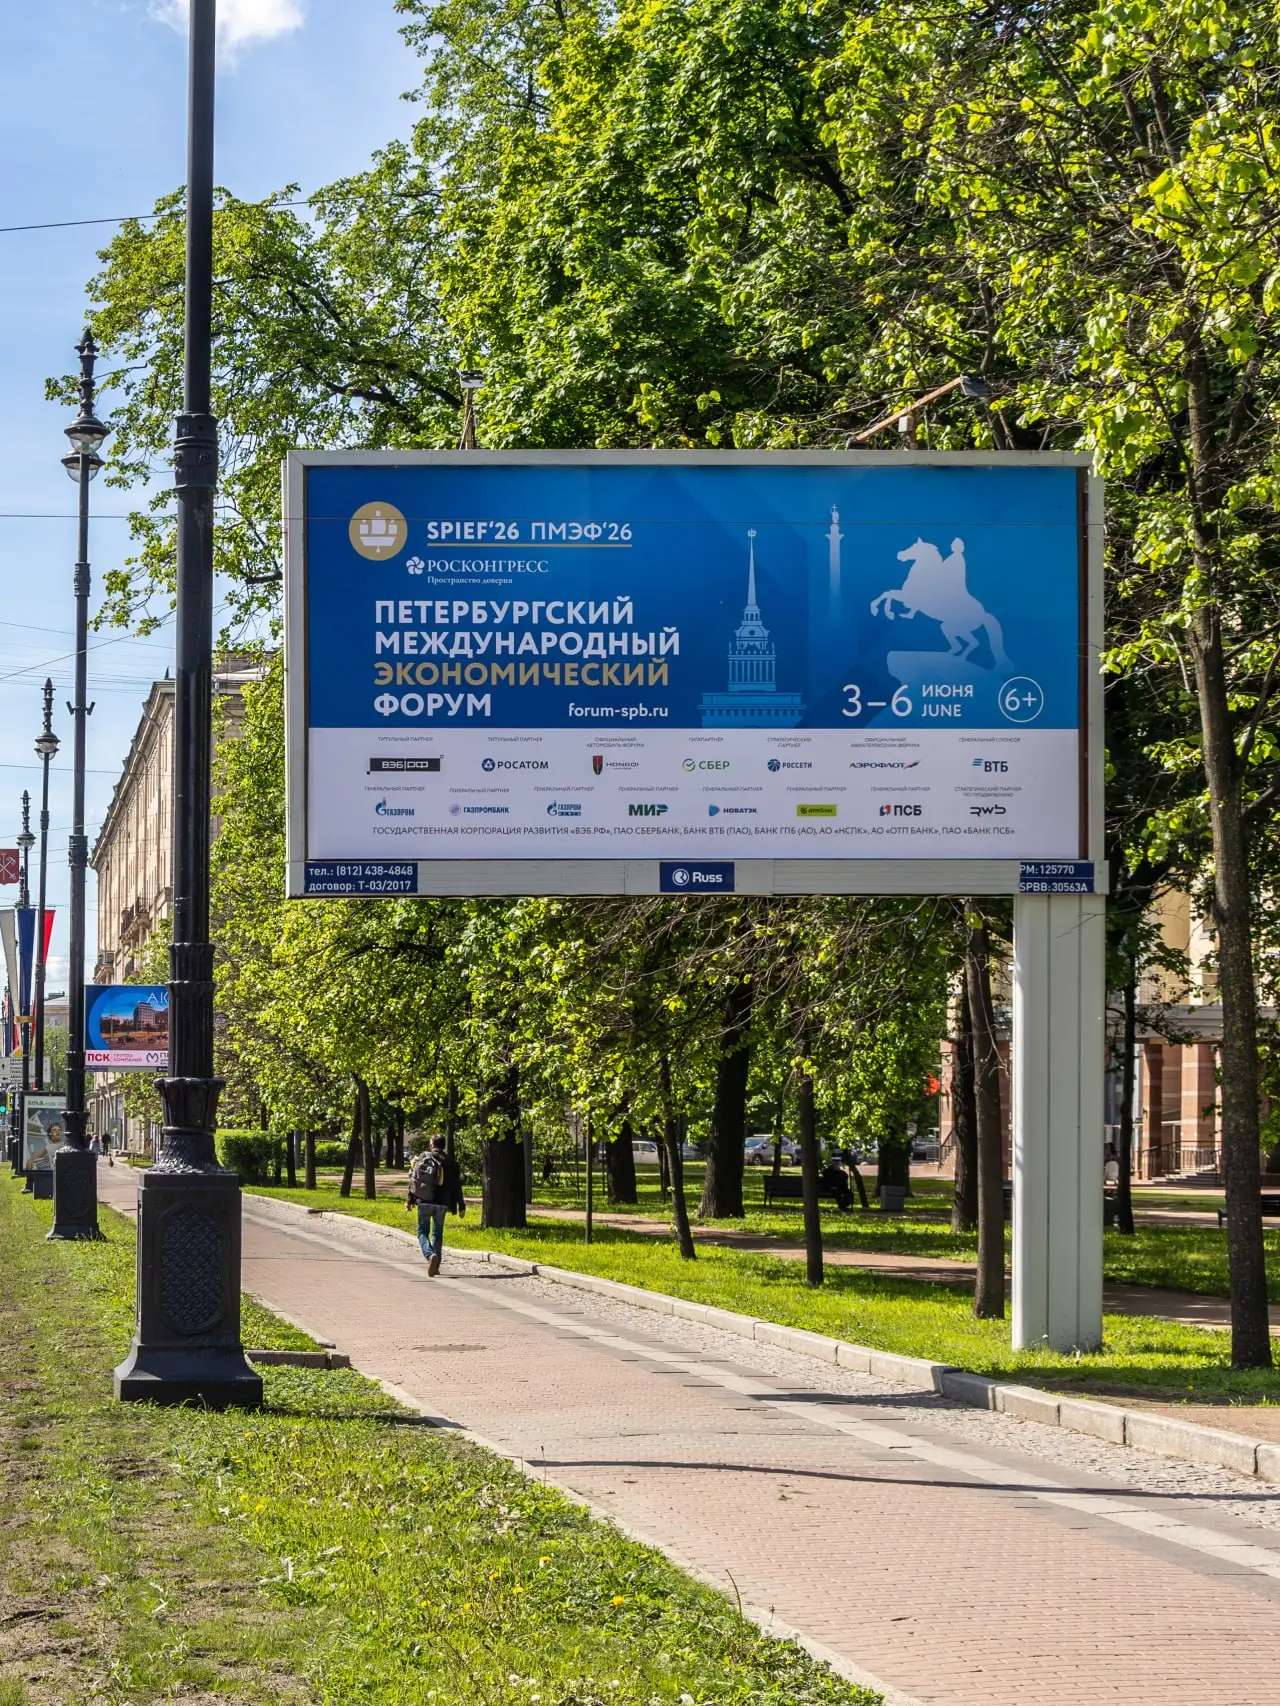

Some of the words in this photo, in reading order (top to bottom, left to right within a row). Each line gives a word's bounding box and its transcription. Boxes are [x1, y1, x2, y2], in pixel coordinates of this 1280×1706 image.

[427, 559, 549, 573] РОСКОНГРЕСС
[427, 576, 480, 585] Пространство
[482, 577, 513, 586] доверия
[375, 595, 634, 625] ПЕТЕРБУРГСКИЙ
[375, 626, 680, 659] МЕЖДУНАРОДНЫЙ
[374, 658, 669, 686] ЭКОНОМИЧЕСКИЙ
[922, 684, 973, 698] ИЮНЯ
[374, 693, 492, 717] ФОРУМ
[1005, 688, 1037, 711] 6+
[568, 702, 669, 721] forum-spb.ru
[921, 704, 962, 717] JUNE
[497, 761, 549, 770] РОСАТОМ
[699, 760, 730, 770] СБЕР
[984, 761, 1009, 772] ВТБ
[386, 808, 415, 816] ГАЗПРОМ
[463, 806, 510, 814] ГАЗПРОМБАНК
[629, 804, 669, 816] МИР
[894, 805, 922, 816] ПСБ
[373, 827, 459, 836] ГОСУДАРСТВЕННАЯ
[461, 827, 521, 836] КОРПОРАЦИЯ
[524, 827, 568, 836] РАЗВИТИЯ
[571, 827, 612, 836] «ВЭБ.РФ»,
[614, 827, 633, 836] ПАО
[635, 827, 682, 836] СБЕРБАНК,
[684, 827, 707, 836] БАНК
[709, 827, 724, 836] ВТБ
[726, 827, 753, 836] (ПАО),
[754, 827, 778, 836] БАНК
[780, 827, 796, 836] ГПБ
[798, 827, 817, 836] (АО),
[820, 827, 832, 836] АО
[834, 827, 869, 836] «НСПК»,
[871, 827, 884, 836] АО
[886, 827, 909, 836] «ОТП
[911, 827, 940, 836] БАНК»,
[942, 827, 961, 836] ПАО
[963, 827, 990, 836] «БАНК
[993, 827, 1015, 836] ПСБ»
[309, 867, 333, 876] тел.:
[336, 865, 362, 878] (812)
[364, 866, 413, 877] 438-4848
[692, 872, 723, 884] Russ
[309, 882, 356, 893] договор:
[358, 880, 411, 891] Т-03/2017
[87, 1053, 110, 1062] ПСК
